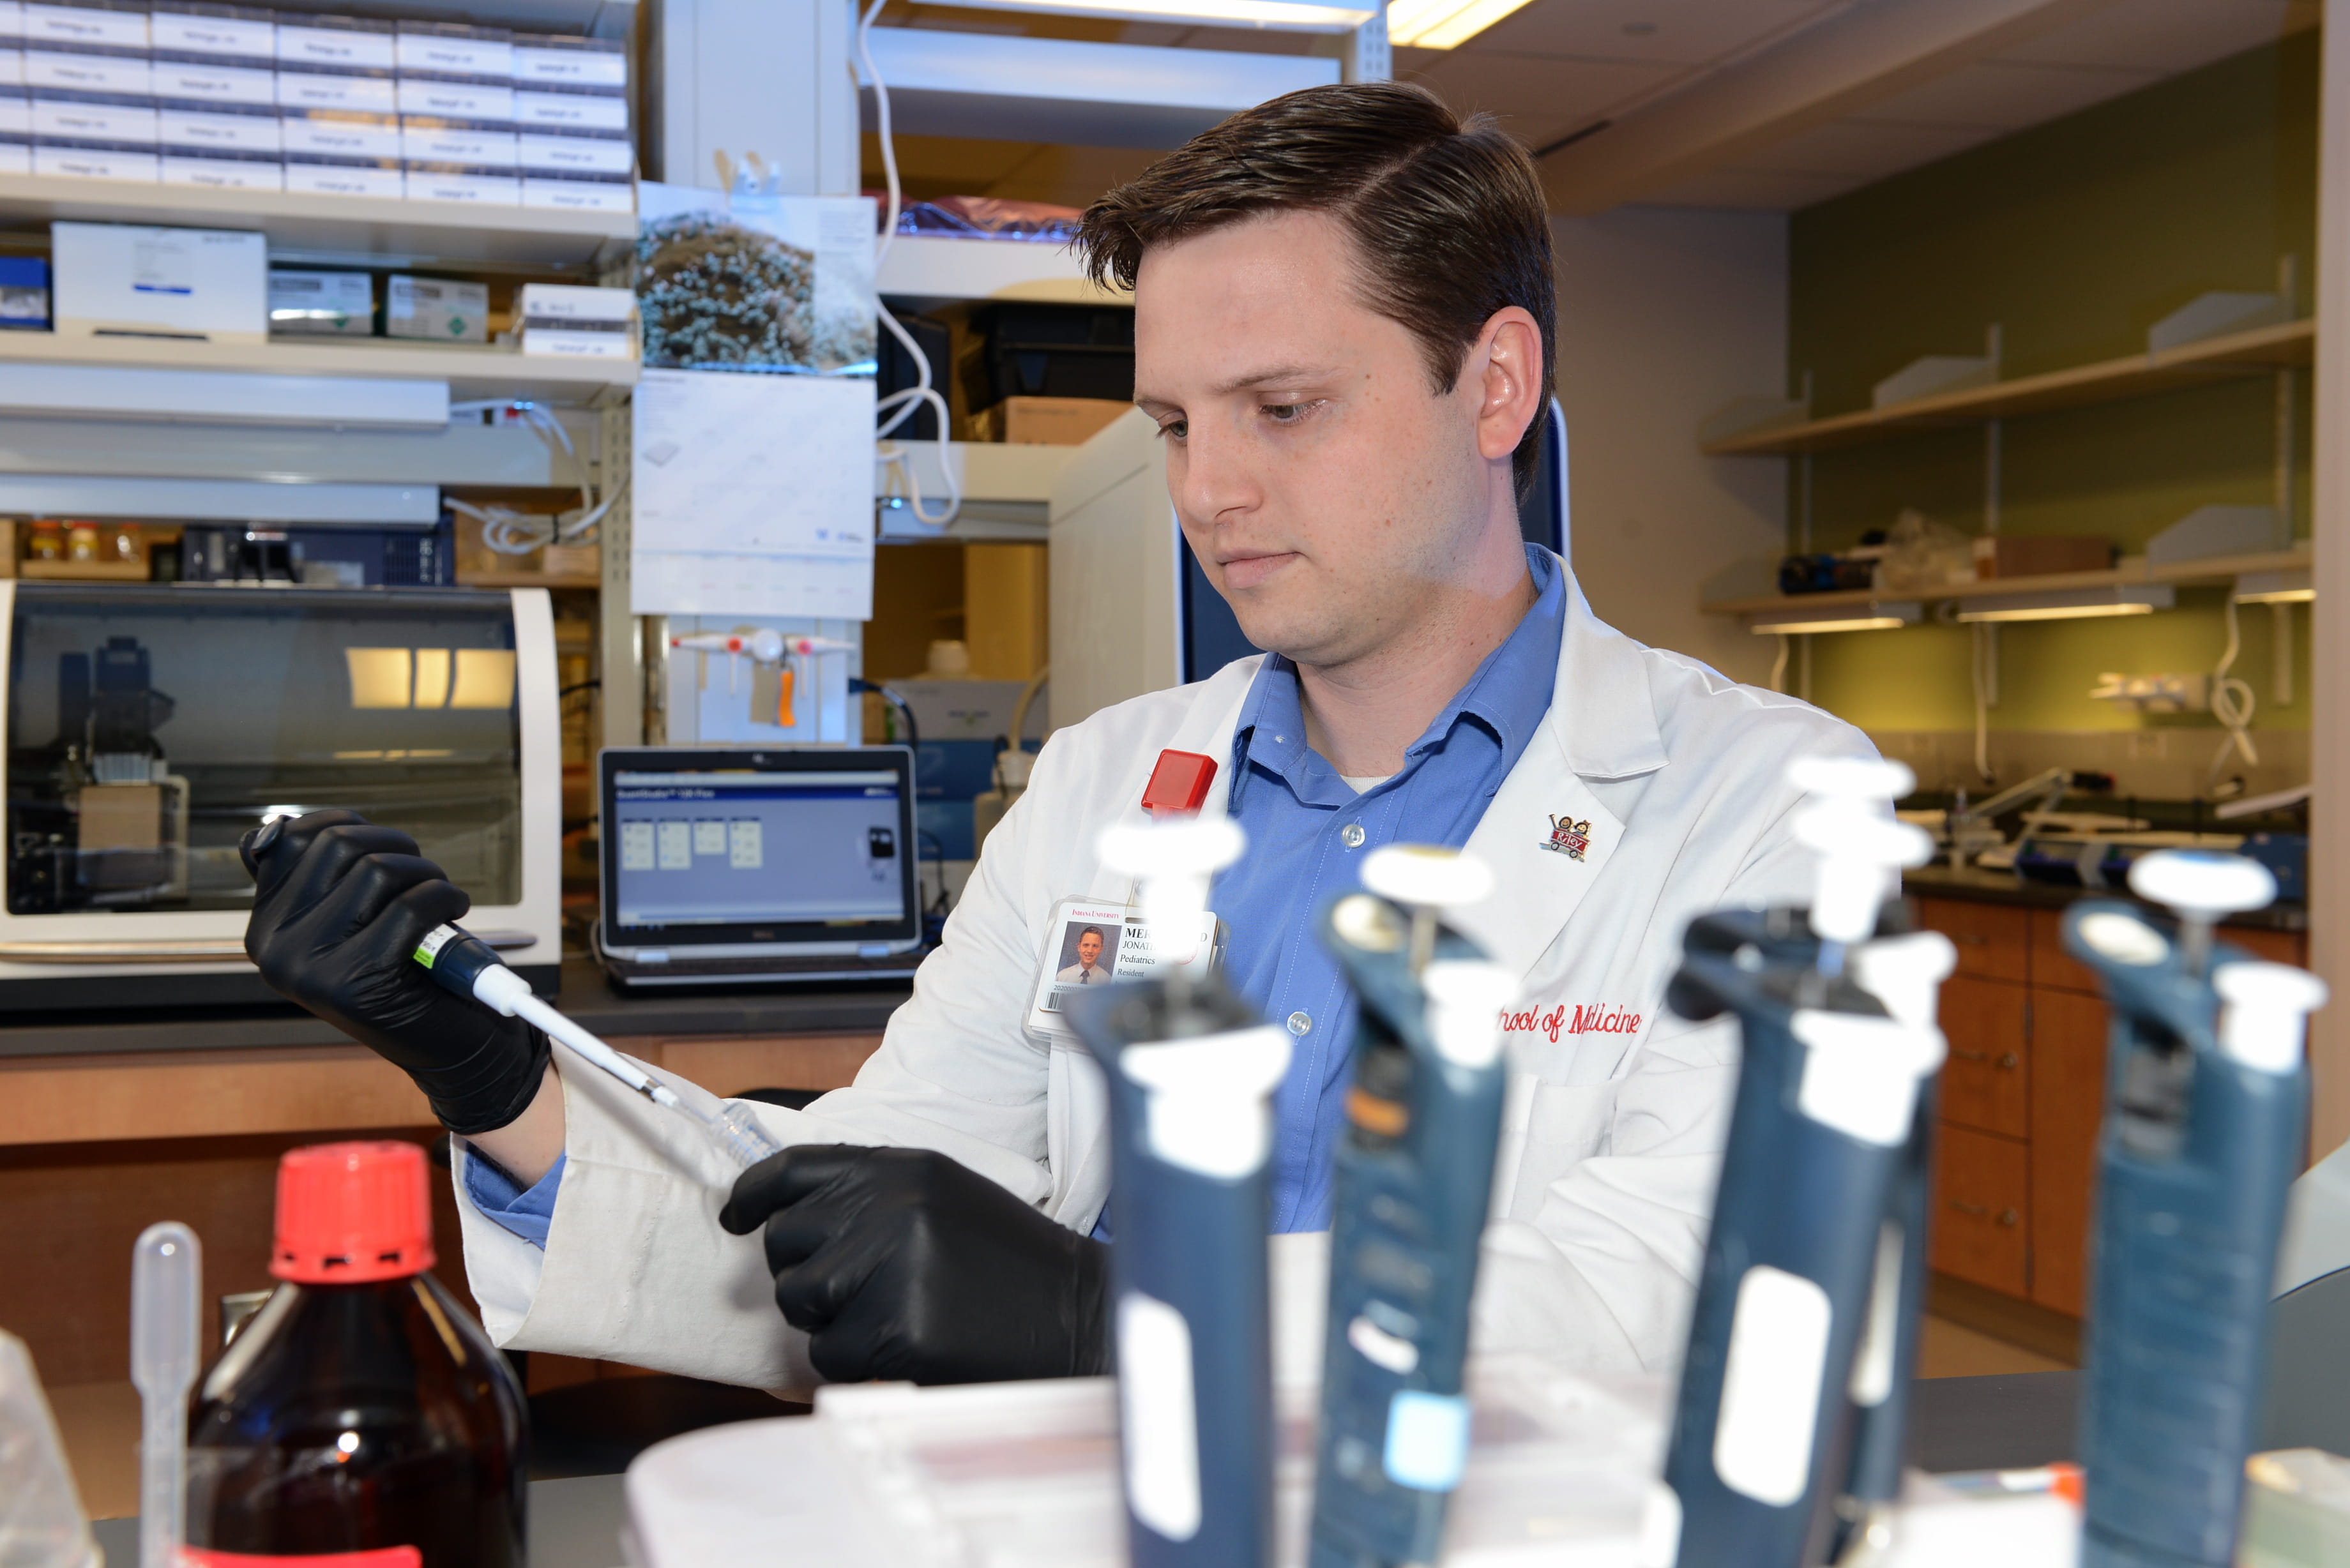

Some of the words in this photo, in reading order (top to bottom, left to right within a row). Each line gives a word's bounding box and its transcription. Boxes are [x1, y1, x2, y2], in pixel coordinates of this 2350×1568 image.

[1558, 832, 1582, 848] Riley
[1120, 954, 1155, 965] Pediatrics
[1118, 969, 1144, 978] Resident
[1496, 1004, 1540, 1032] hool
[1542, 1004, 1565, 1043] of
